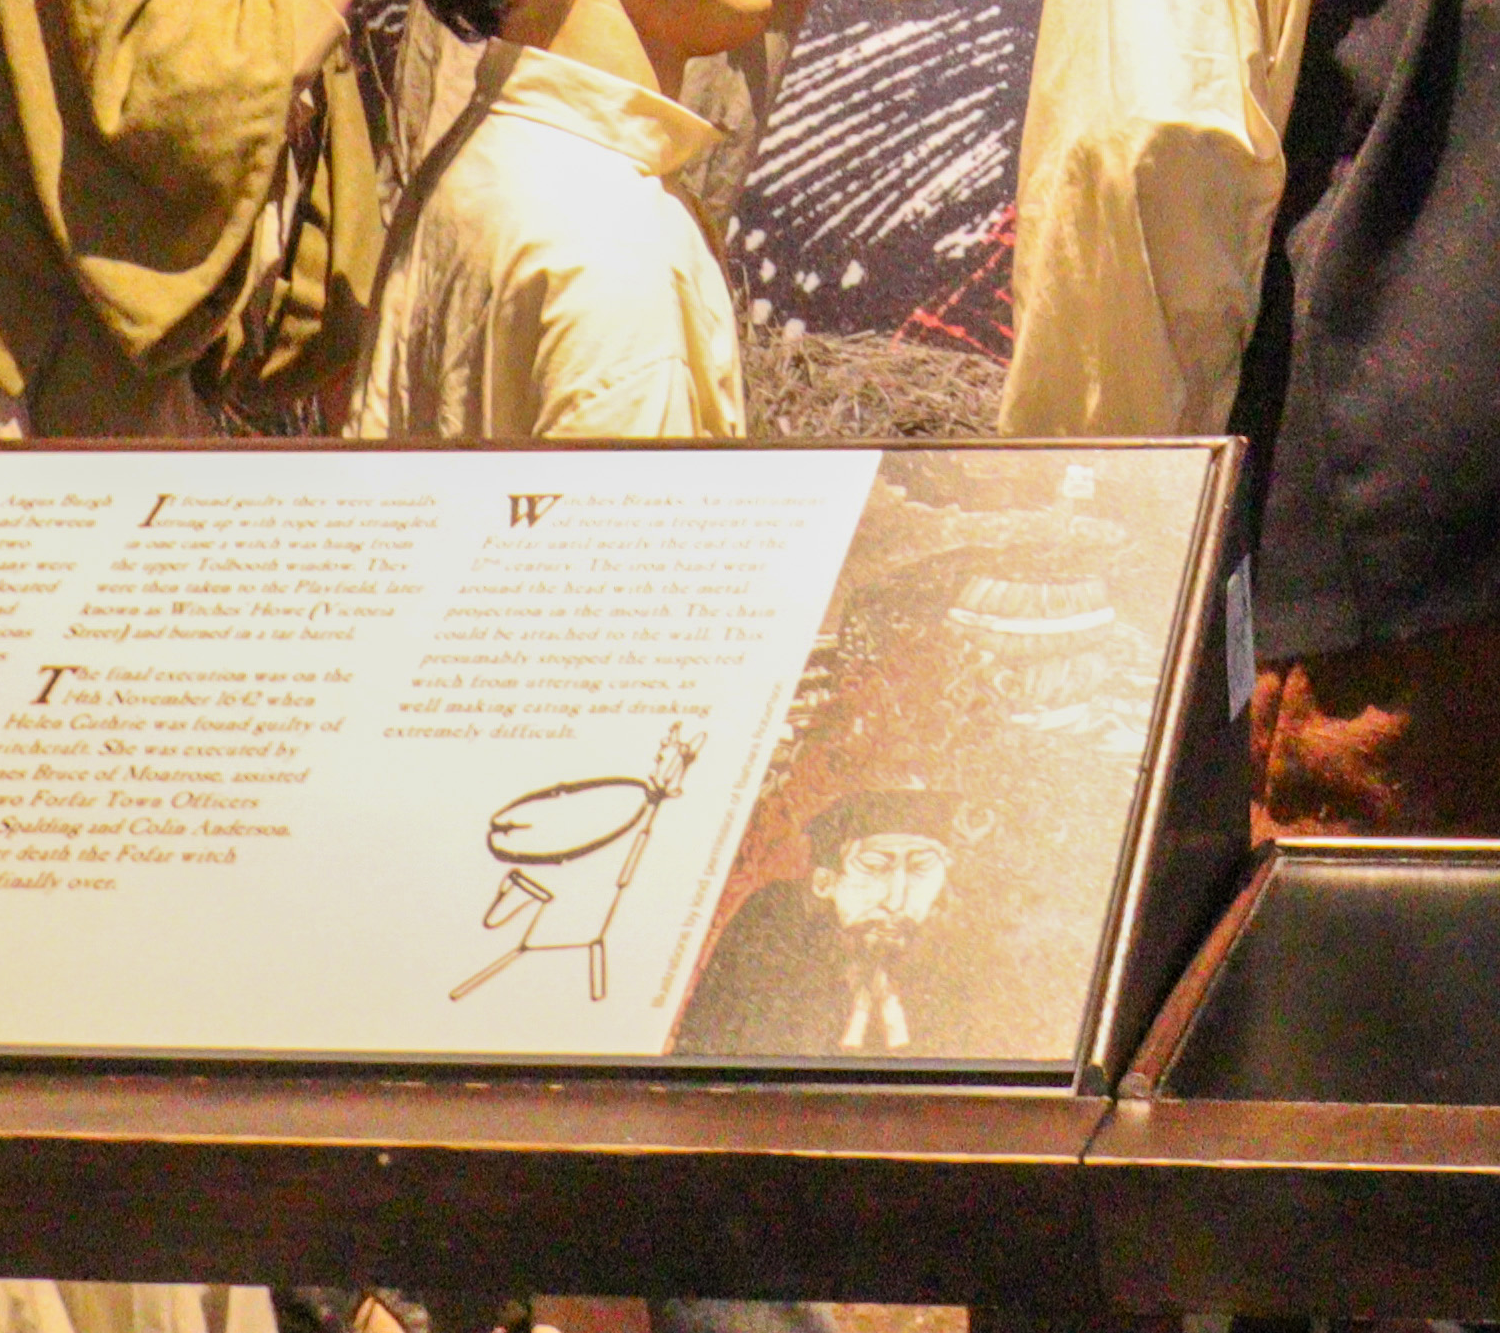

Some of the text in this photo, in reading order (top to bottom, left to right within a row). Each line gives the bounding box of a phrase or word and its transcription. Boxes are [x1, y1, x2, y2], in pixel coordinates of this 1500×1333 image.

[30, 664, 353, 706] The final execution was on the
[107, 689, 315, 707] November when
[2, 712, 345, 736] Helen Guthrie was found guilty of
[96, 737, 300, 761] She was executed by
[31, 763, 89, 782] Bruce
[93, 765, 120, 782] of
[230, 768, 310, 784] assisted
[28, 789, 97, 808] Forfar
[106, 789, 163, 809] Town
[170, 790, 259, 810] Officers
[86, 818, 126, 835] and
[128, 817, 187, 836] Colin
[15, 844, 71, 862] death
[76, 844, 111, 863] the
[181, 846, 236, 864] witch
